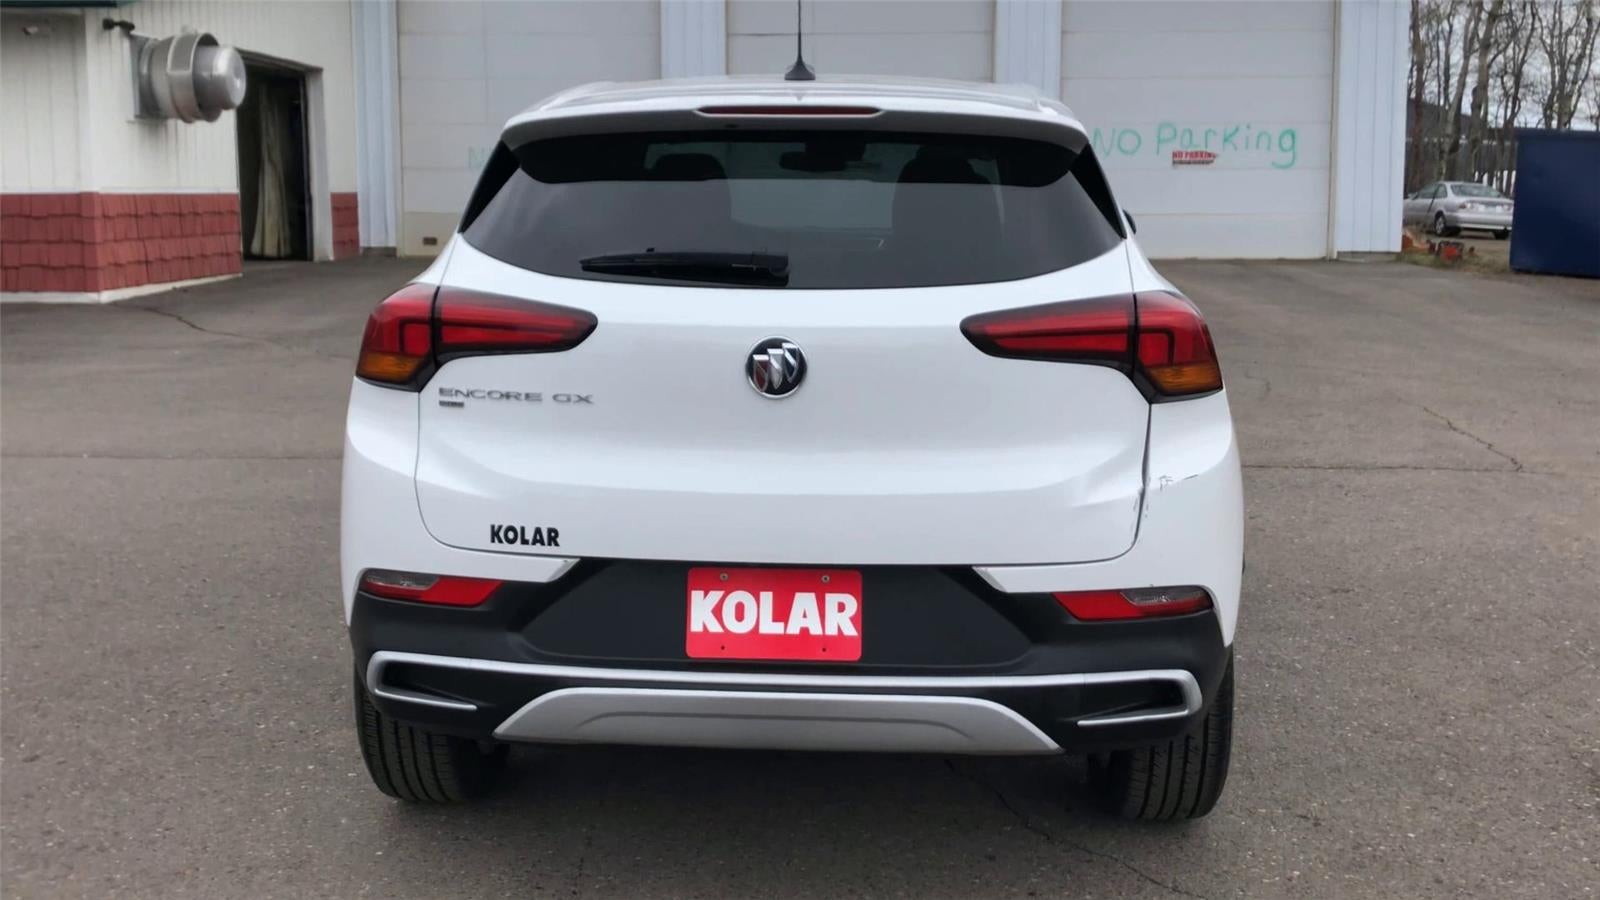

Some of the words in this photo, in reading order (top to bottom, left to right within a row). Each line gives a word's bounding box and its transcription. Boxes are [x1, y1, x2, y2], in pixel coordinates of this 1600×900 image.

[1093, 127, 1142, 156] NO
[439, 387, 542, 402] ENCORE
[552, 393, 594, 404] GX
[490, 524, 560, 547] KOLAR
[690, 590, 859, 636] KOLAR
